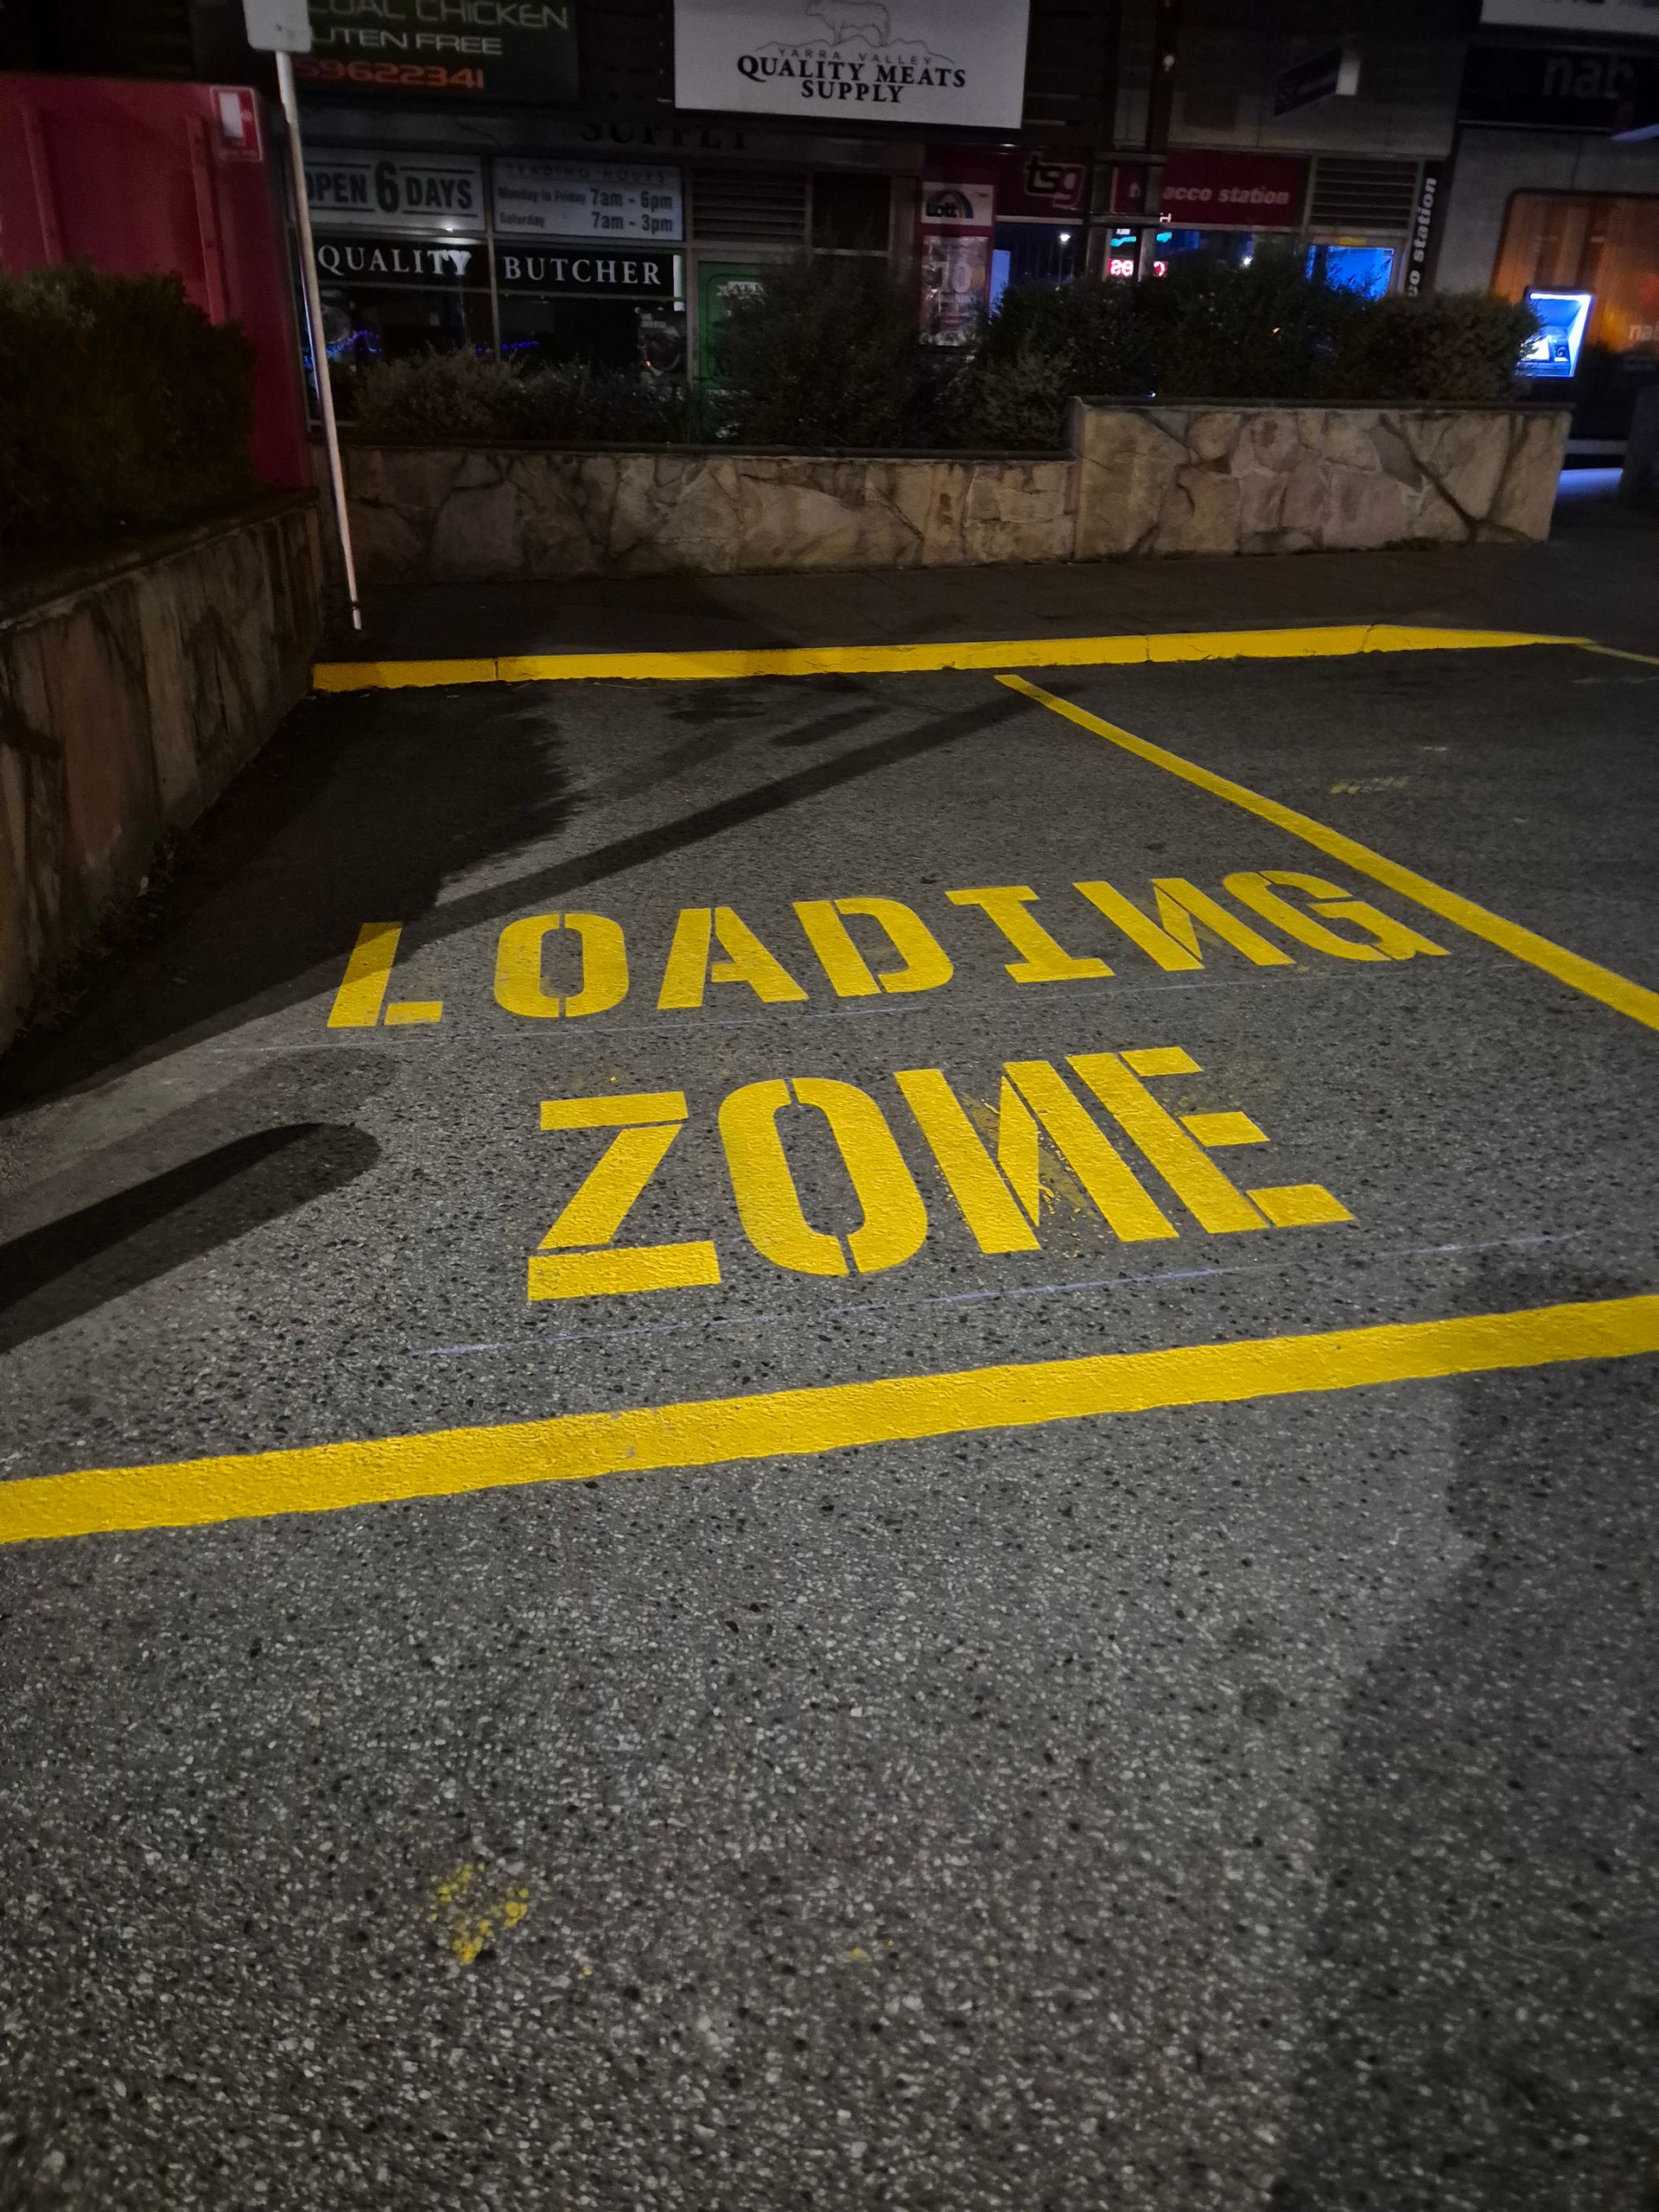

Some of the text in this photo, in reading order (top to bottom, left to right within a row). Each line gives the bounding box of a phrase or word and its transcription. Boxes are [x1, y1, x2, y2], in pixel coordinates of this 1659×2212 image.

[416, 0, 568, 29] CHICKEN
[312, 26, 503, 55] UTEN FREE
[738, 54, 966, 87] QUALITY MEATS
[779, 48, 932, 66] YARRA VALLEY
[801, 79, 905, 103] SUPPLY
[375, 161, 400, 213] 6
[406, 176, 473, 209] DAYS
[1026, 151, 1086, 211] tsg
[1217, 186, 1291, 206] station
[590, 188, 623, 207] 7am
[640, 190, 673, 213] 6pm
[591, 212, 624, 229] 7am
[641, 213, 673, 235] 3pm
[1413, 177, 1438, 263] station
[317, 244, 663, 286] QUALITY BUTCHER
[327, 869, 1452, 1029] LOADING
[526, 1045, 1356, 1302] ZONE
